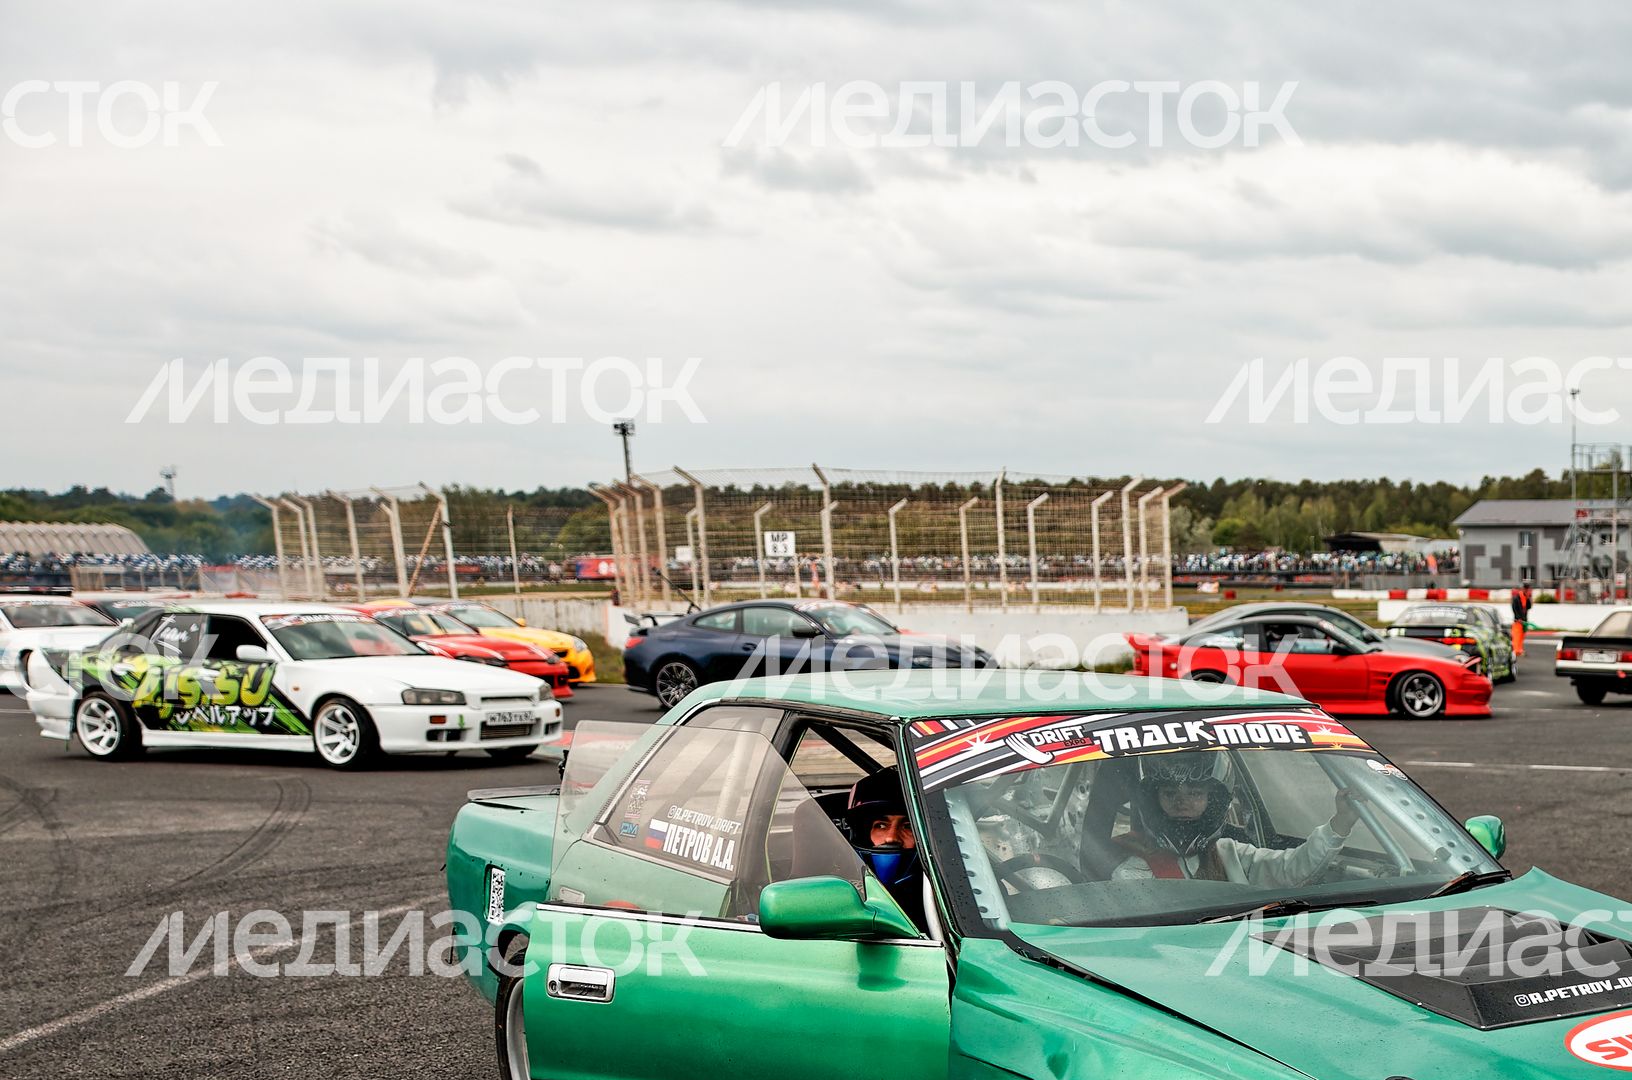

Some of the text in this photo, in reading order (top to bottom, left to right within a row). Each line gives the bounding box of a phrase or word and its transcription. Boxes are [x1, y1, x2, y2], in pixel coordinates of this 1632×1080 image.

[1029, 725, 1085, 747] DRIFT
[1093, 721, 1306, 752] TRACK MODE
[663, 824, 735, 871] ПЕТРОВ А.А.
